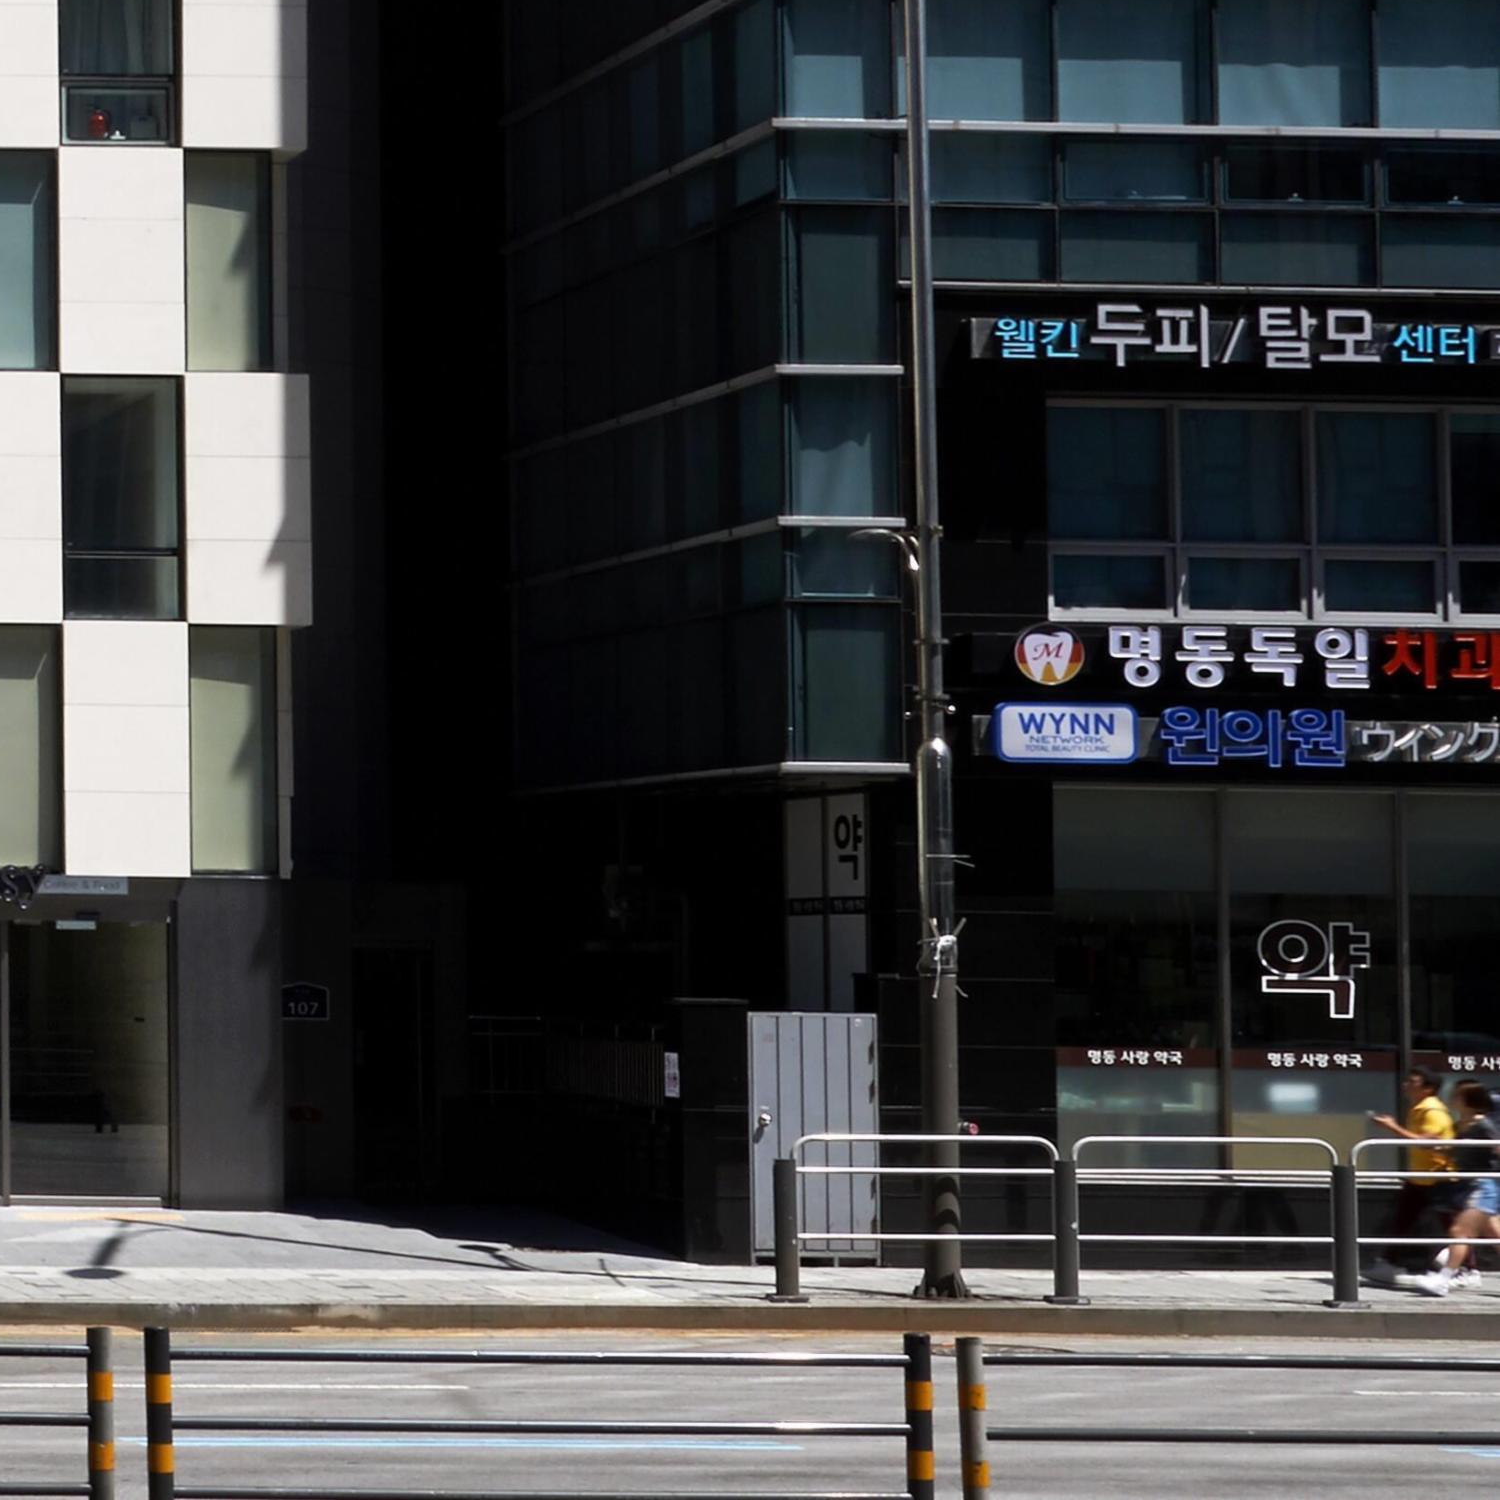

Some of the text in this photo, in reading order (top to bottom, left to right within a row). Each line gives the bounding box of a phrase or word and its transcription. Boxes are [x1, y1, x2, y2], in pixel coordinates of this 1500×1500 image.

[994, 317, 1079, 359] 웰킨
[1090, 302, 1381, 368] 두피/탈모
[1393, 324, 1476, 364] 센터
[1018, 712, 1115, 736] WYNN
[1029, 735, 1104, 745] NETWORK
[1160, 706, 1346, 768] 윈의원
[834, 814, 863, 881] 약
[1257, 919, 1371, 1019] 약
[287, 1001, 319, 1016] 107
[1087, 1049, 1183, 1065] 명동 사랑 약국
[1267, 1052, 1363, 1068] 명동 사랑 약국
[1447, 1055, 1500, 1071] 명동 사
